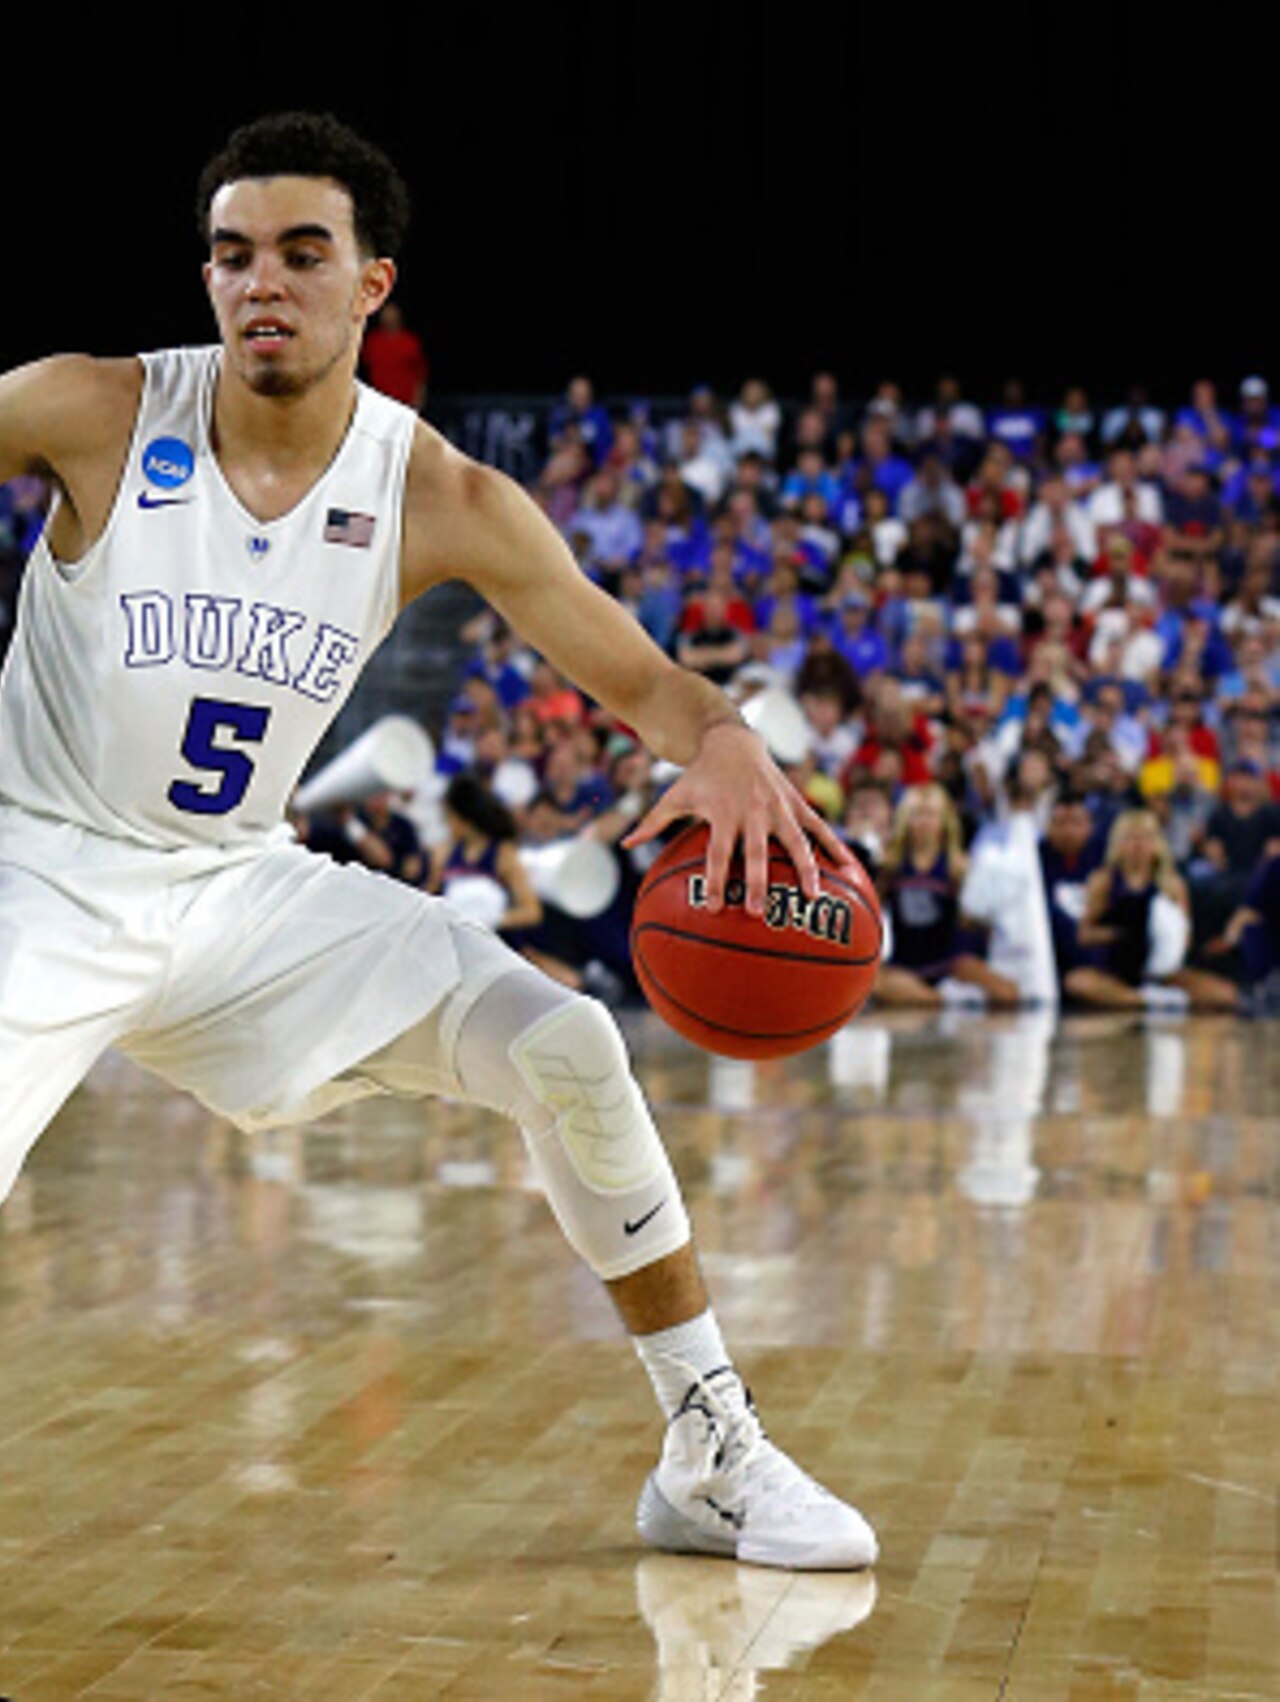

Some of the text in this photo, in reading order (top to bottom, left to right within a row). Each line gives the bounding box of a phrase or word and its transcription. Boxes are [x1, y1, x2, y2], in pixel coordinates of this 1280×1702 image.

[119, 590, 359, 702] DUKE
[167, 696, 272, 815] 5
[689, 875, 852, 944] Wilon
